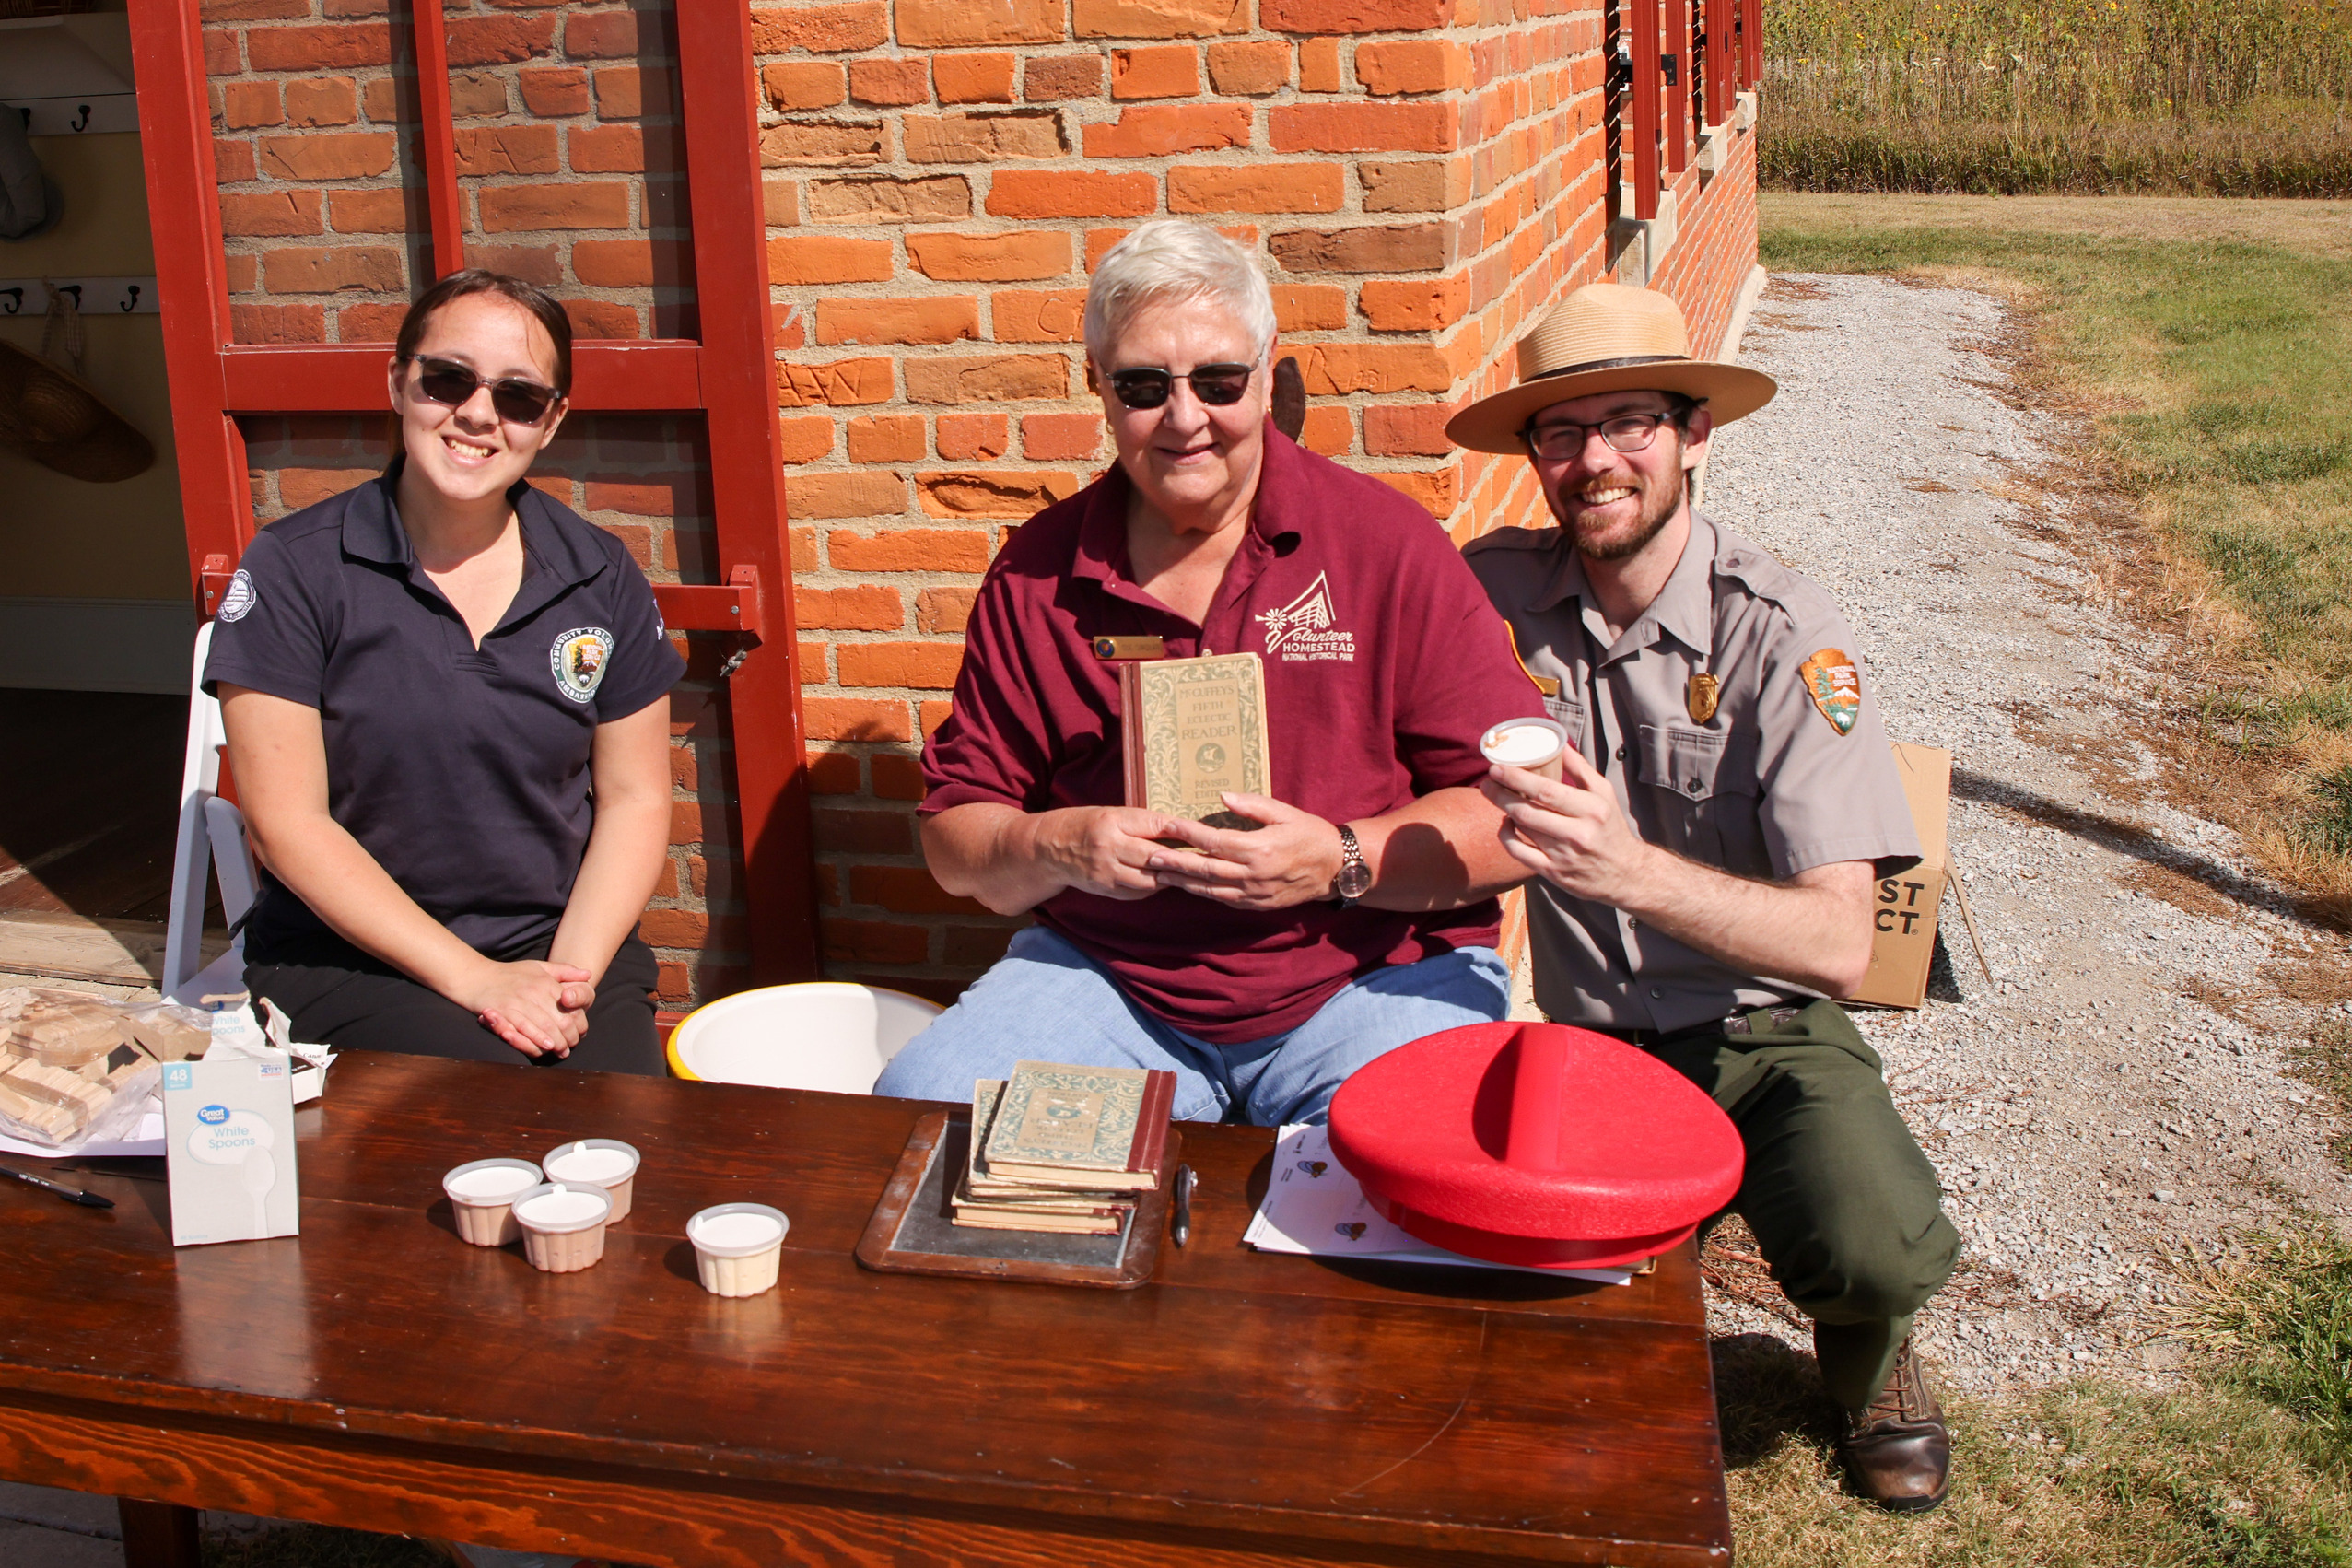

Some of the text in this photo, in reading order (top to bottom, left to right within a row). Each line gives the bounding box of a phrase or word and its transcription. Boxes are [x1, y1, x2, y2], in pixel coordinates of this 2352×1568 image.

[1265, 626, 1353, 655] Volunteer
[553, 629, 582, 671] COMMUNITY
[1282, 642, 1356, 653] HOMESTEAD
[1282, 652, 1354, 662] NATIONAL HISTORICAL PARK
[1192, 701, 1223, 711] FIFTH
[1187, 713, 1232, 724] ECLECTIC
[1181, 725, 1238, 740] READER
[169, 1068, 188, 1082] 48
[200, 1108, 225, 1117] Great
[213, 1126, 250, 1138] White
[208, 1137, 256, 1151] Spoons
